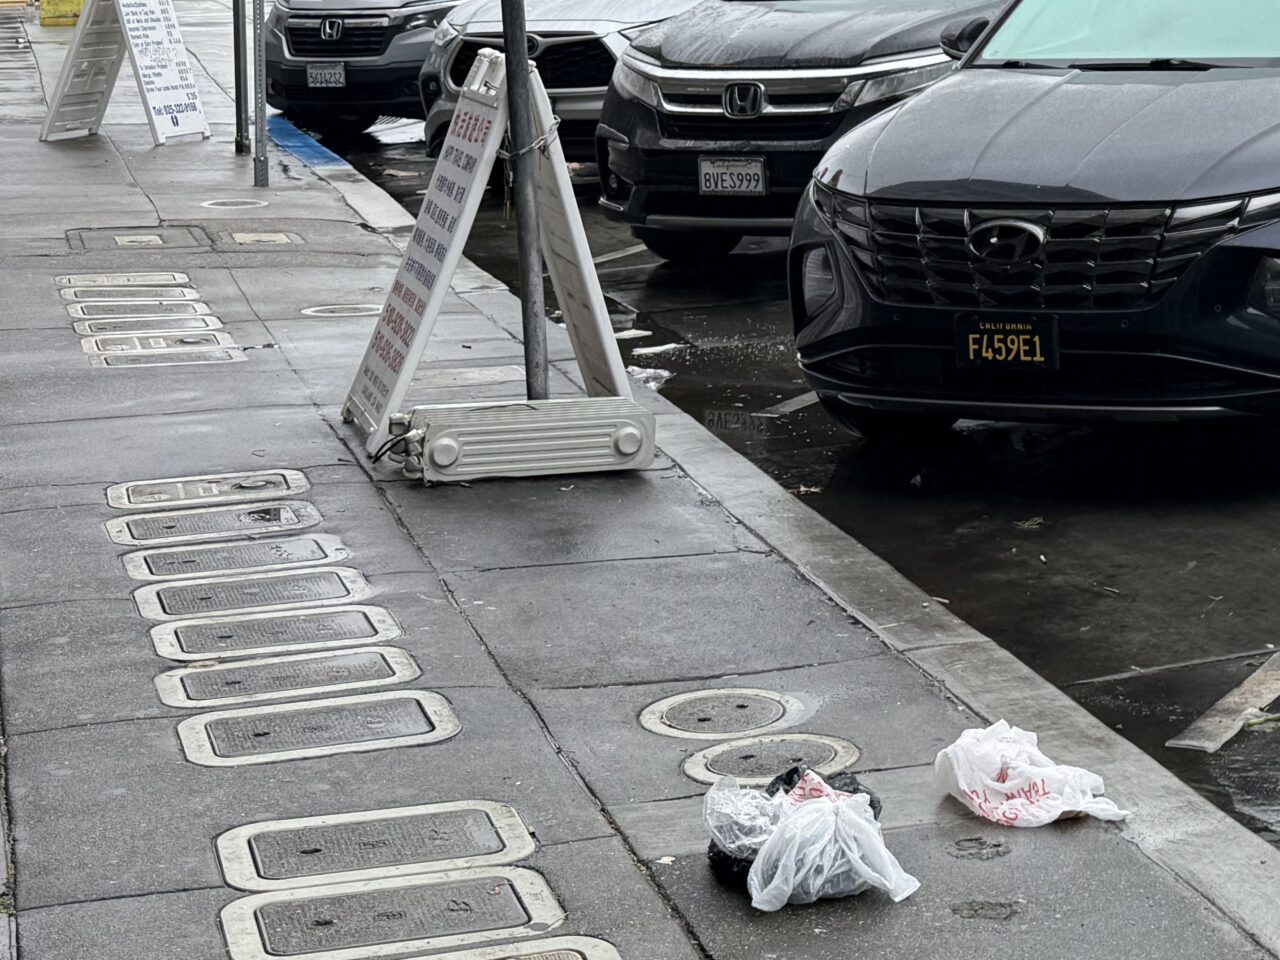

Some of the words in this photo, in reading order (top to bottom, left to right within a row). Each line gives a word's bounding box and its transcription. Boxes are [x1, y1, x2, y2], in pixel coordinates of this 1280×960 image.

[703, 171, 760, 190] 8VES999
[979, 322, 1033, 330] CALIFORNIA
[968, 334, 1045, 362] F459E1
